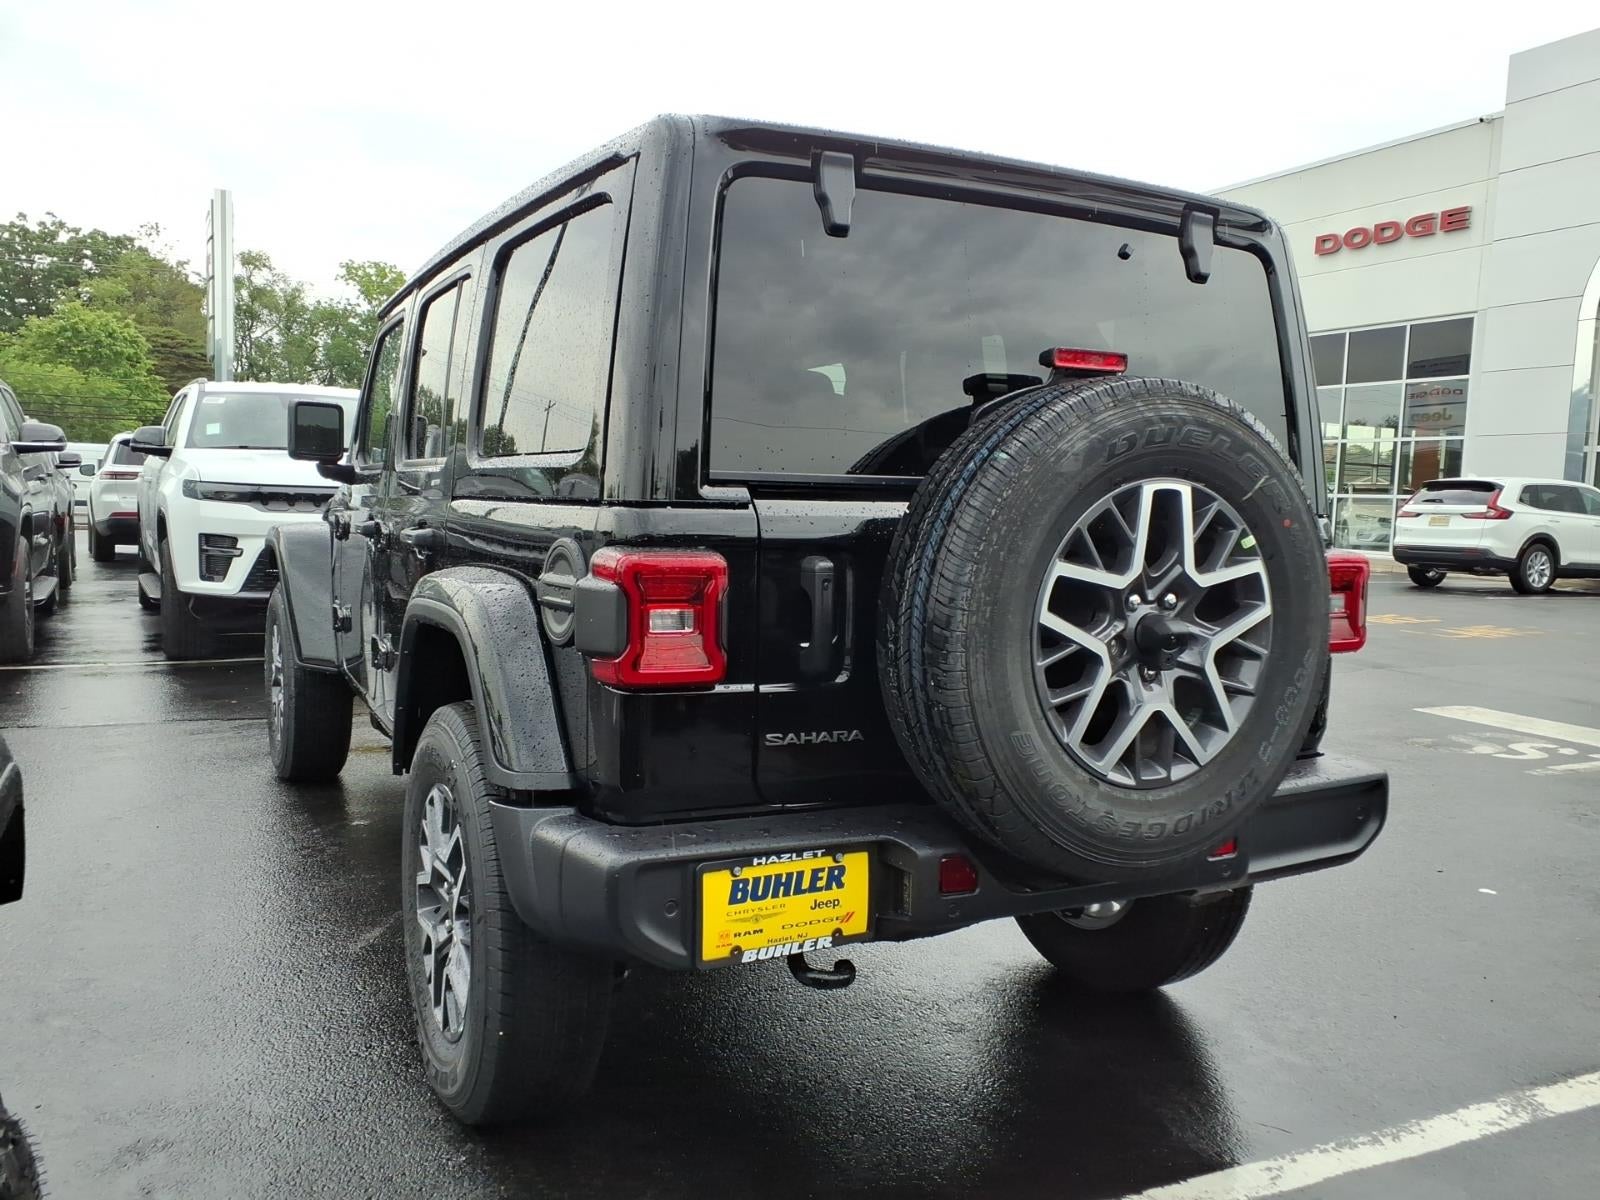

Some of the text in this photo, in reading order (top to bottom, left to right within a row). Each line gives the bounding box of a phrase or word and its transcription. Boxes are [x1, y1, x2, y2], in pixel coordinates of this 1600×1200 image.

[1314, 205, 1472, 256] DODGE
[765, 729, 864, 746] SAHARA
[752, 849, 826, 866] HAZLET
[728, 864, 846, 906] BUHLER
[726, 903, 786, 917] CHRYSLER
[810, 898, 840, 911] Jeep
[781, 915, 845, 930] DODGE
[733, 928, 764, 939] RAM
[741, 936, 833, 964] BUHLER
